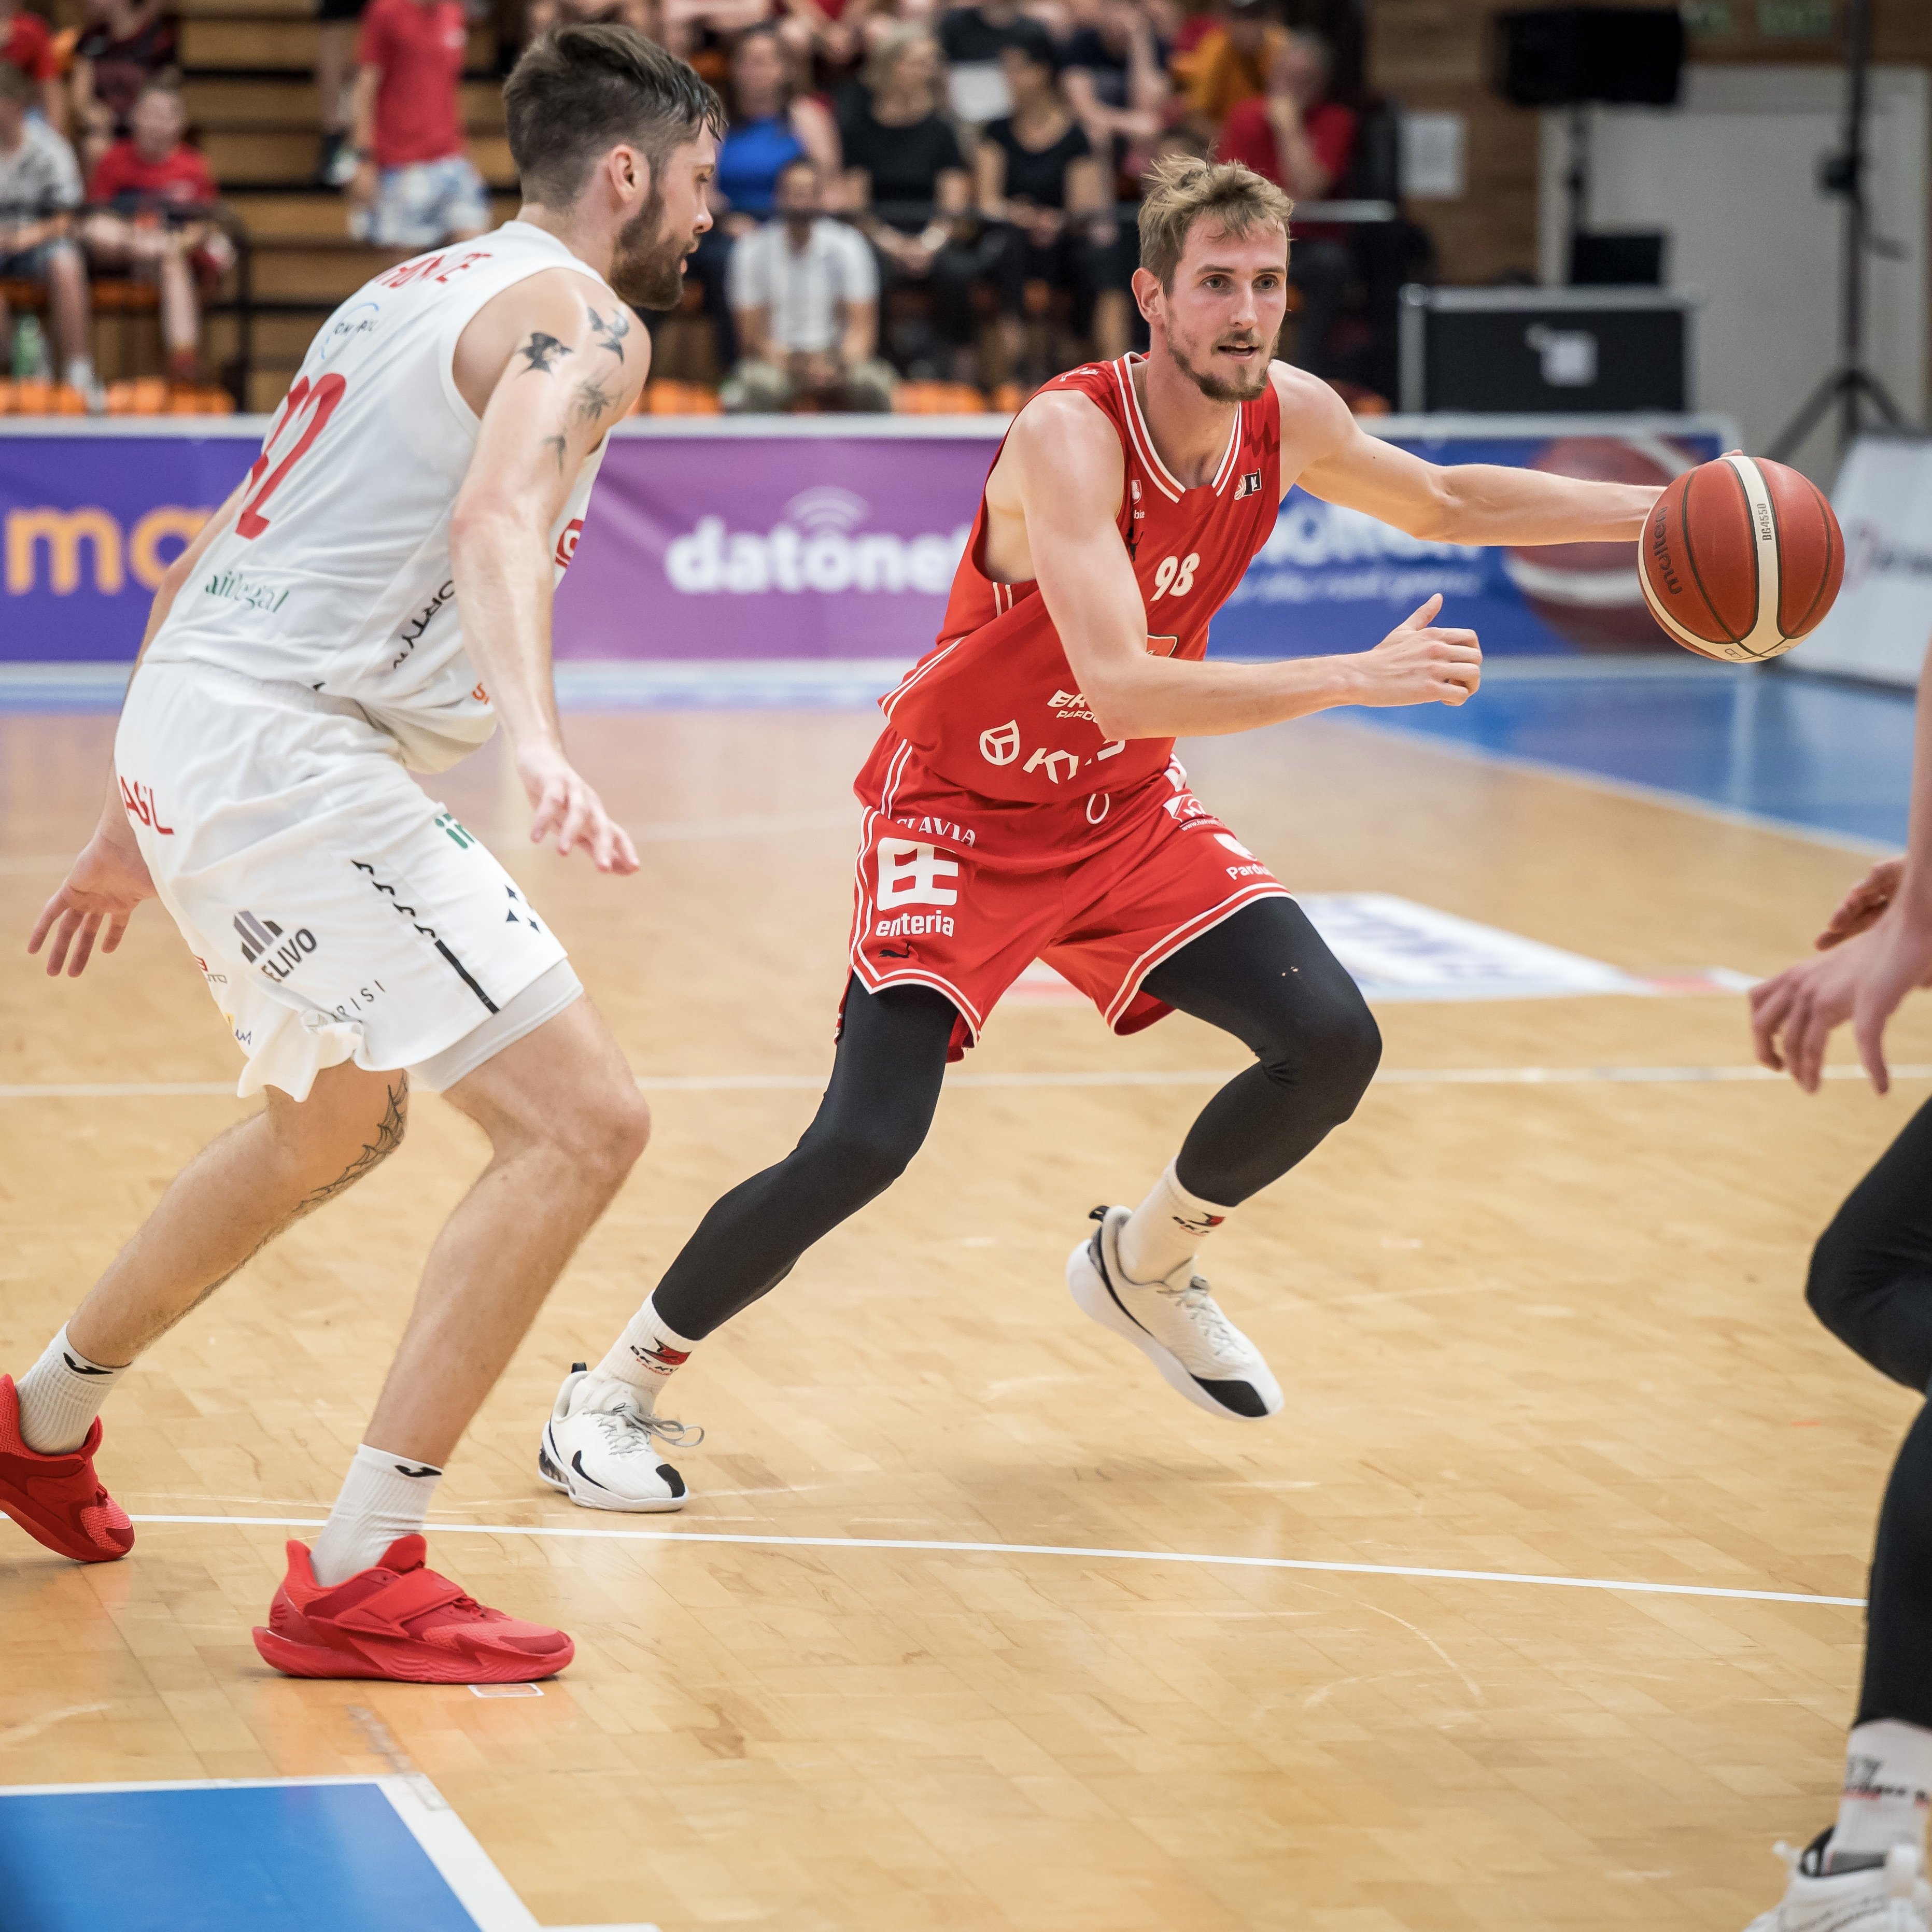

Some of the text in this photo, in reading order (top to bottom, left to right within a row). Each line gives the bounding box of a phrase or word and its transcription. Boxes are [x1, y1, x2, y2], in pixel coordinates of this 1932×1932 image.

[1757, 503, 1772, 541] BG4550
[1150, 552, 1201, 602] 98
[875, 910, 954, 937] enteria
